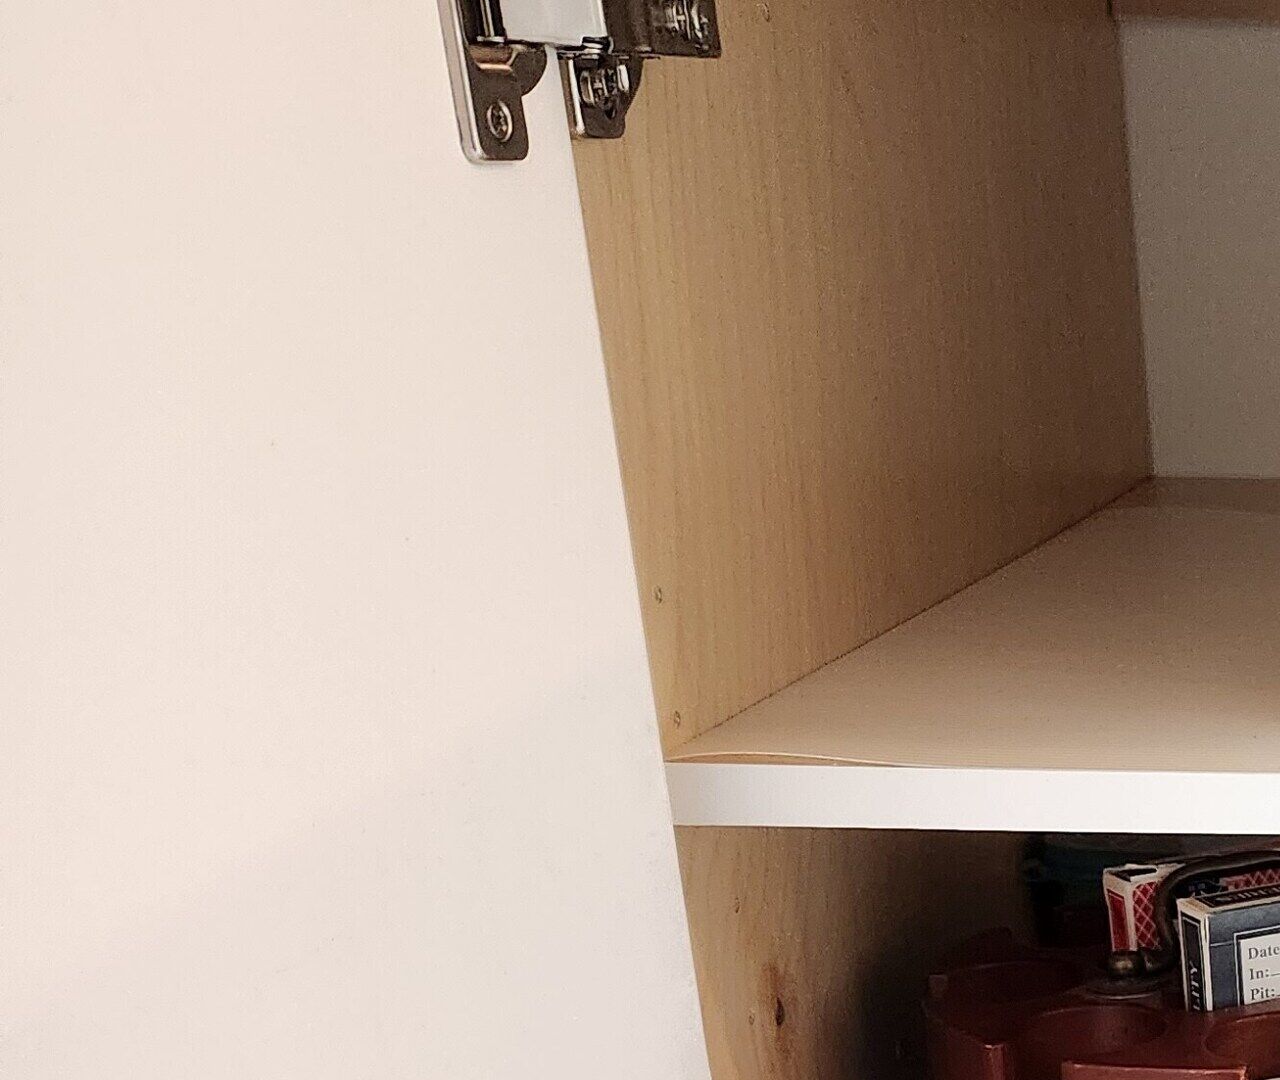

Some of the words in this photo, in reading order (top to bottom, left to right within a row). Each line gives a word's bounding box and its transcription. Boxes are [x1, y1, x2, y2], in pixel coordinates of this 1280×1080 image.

[1248, 944, 1280, 960] Date
[1250, 968, 1270, 981] In:
[1250, 988, 1275, 1002] Pit:
